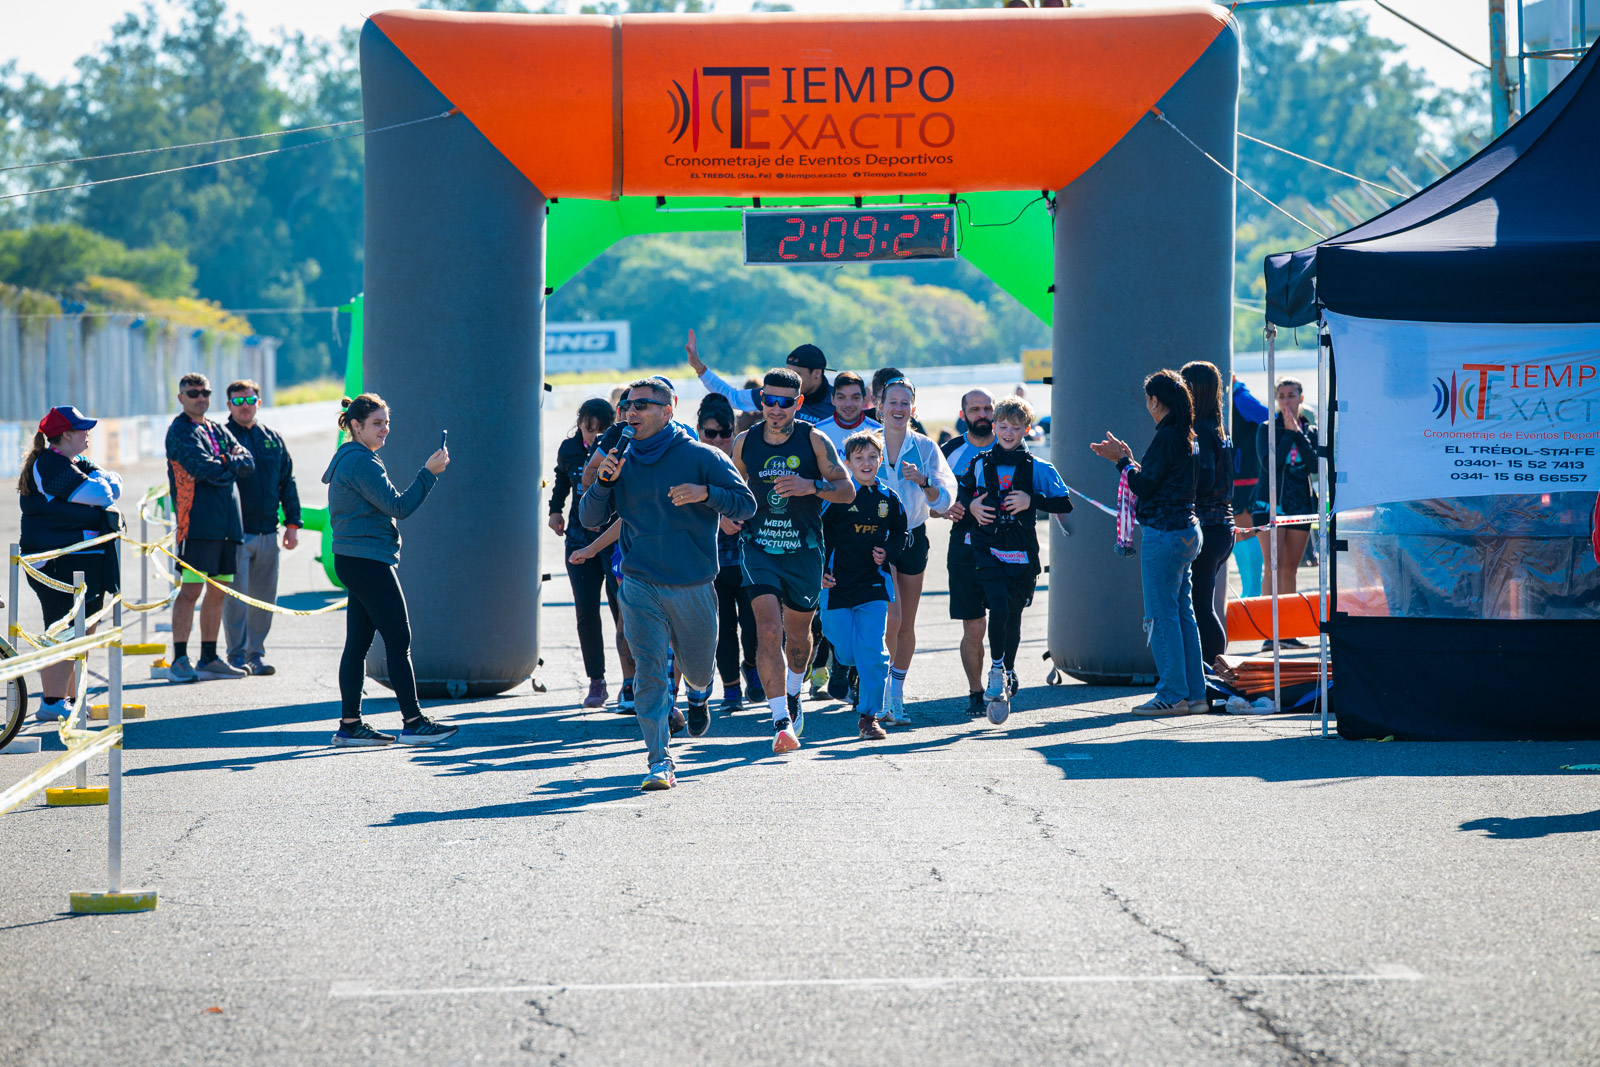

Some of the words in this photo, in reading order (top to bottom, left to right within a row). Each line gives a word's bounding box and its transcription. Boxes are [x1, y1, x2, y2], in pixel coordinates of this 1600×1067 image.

[744, 79, 955, 150] EXACTO
[664, 155, 771, 168] Cronometraje
[774, 155, 795, 166] de
[799, 154, 861, 166] Eventos
[866, 153, 953, 167] Deportivos
[862, 171, 896, 179] Tiempo
[778, 213, 950, 260] 2:09:27
[800, 413, 820, 423] TEAM
[1423, 429, 1496, 441] Cronometraje
[1498, 431, 1512, 440] de
[1515, 431, 1559, 440] Eventos
[1445, 446, 1465, 454] EL
[789, 457, 797, 467] 3
[1454, 459, 1503, 468] 03401-
[1508, 460, 1523, 468] 15
[1528, 461, 1547, 469] 52
[1552, 461, 1585, 469] 7413
[1450, 472, 1490, 480] 0341-
[1494, 473, 1509, 481] 15
[1539, 474, 1588, 482] 66557
[764, 518, 792, 529] MEDIA
[853, 523, 879, 534] YPF
[758, 528, 800, 539] MARATÓN
[755, 538, 802, 550] NOCTURNA
